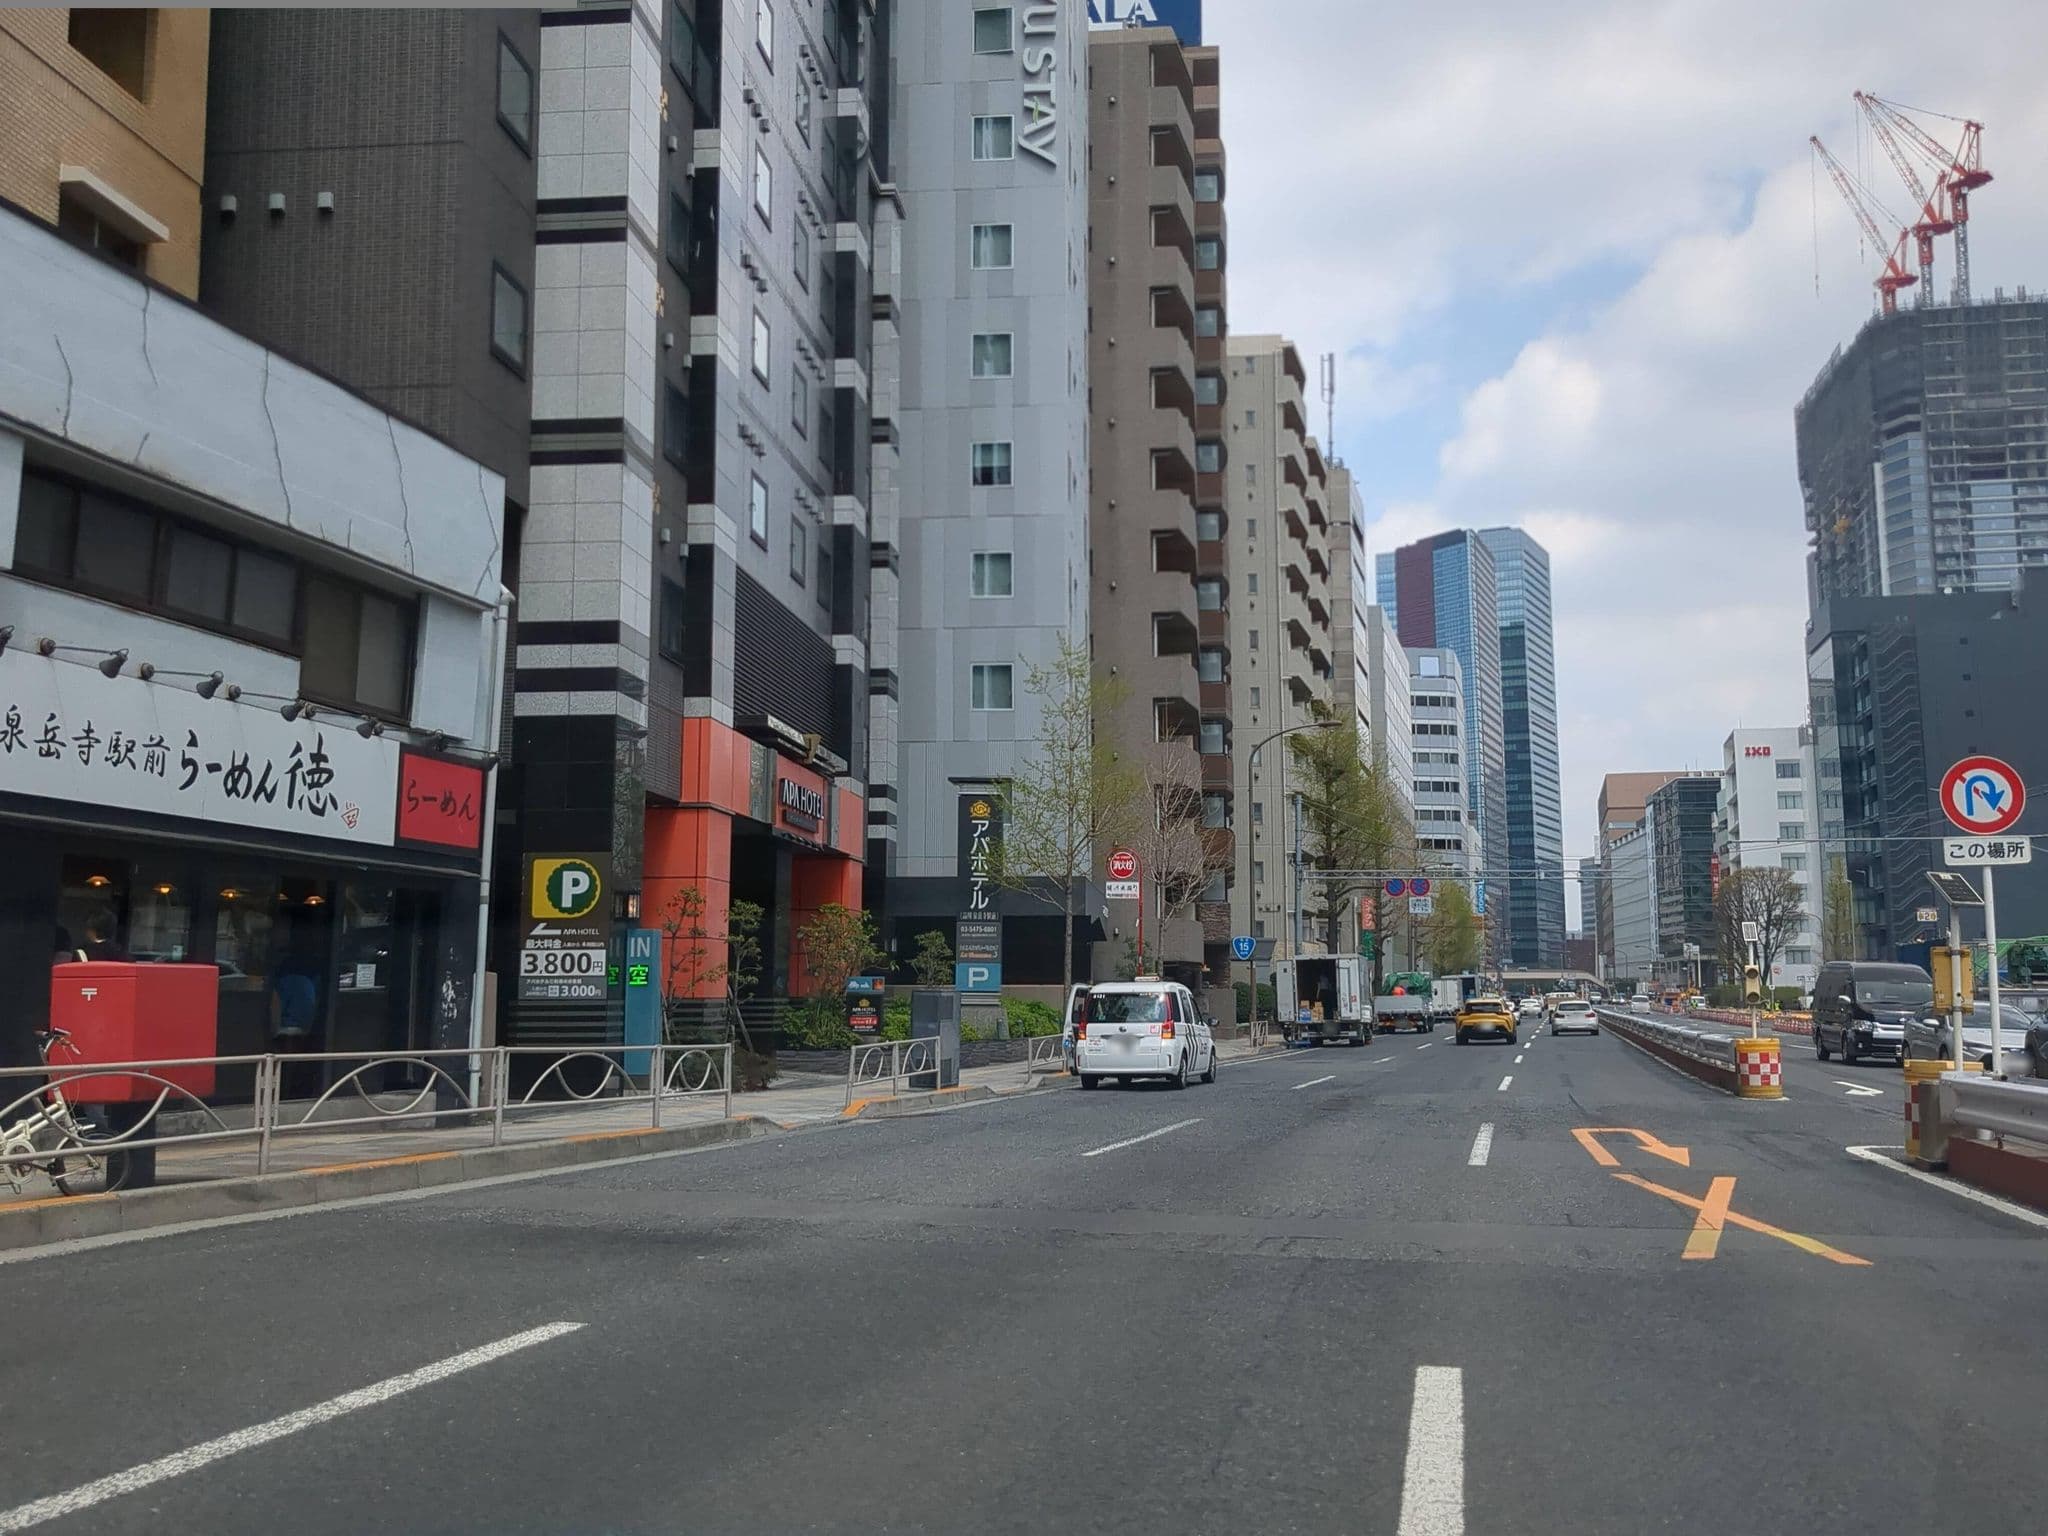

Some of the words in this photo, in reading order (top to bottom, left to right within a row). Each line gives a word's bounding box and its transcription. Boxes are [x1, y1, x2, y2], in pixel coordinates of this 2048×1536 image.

[407, 778, 476, 821] らーめん
[782, 779, 800, 809] APA
[800, 786, 824, 819] HOTEL
[1950, 841, 2025, 859] この場所
[969, 819, 990, 909] アパホテル
[561, 870, 590, 908] P
[630, 936, 650, 957] IN
[1239, 942, 1249, 951] 15
[629, 964, 648, 985] 空
[968, 967, 989, 988] P
